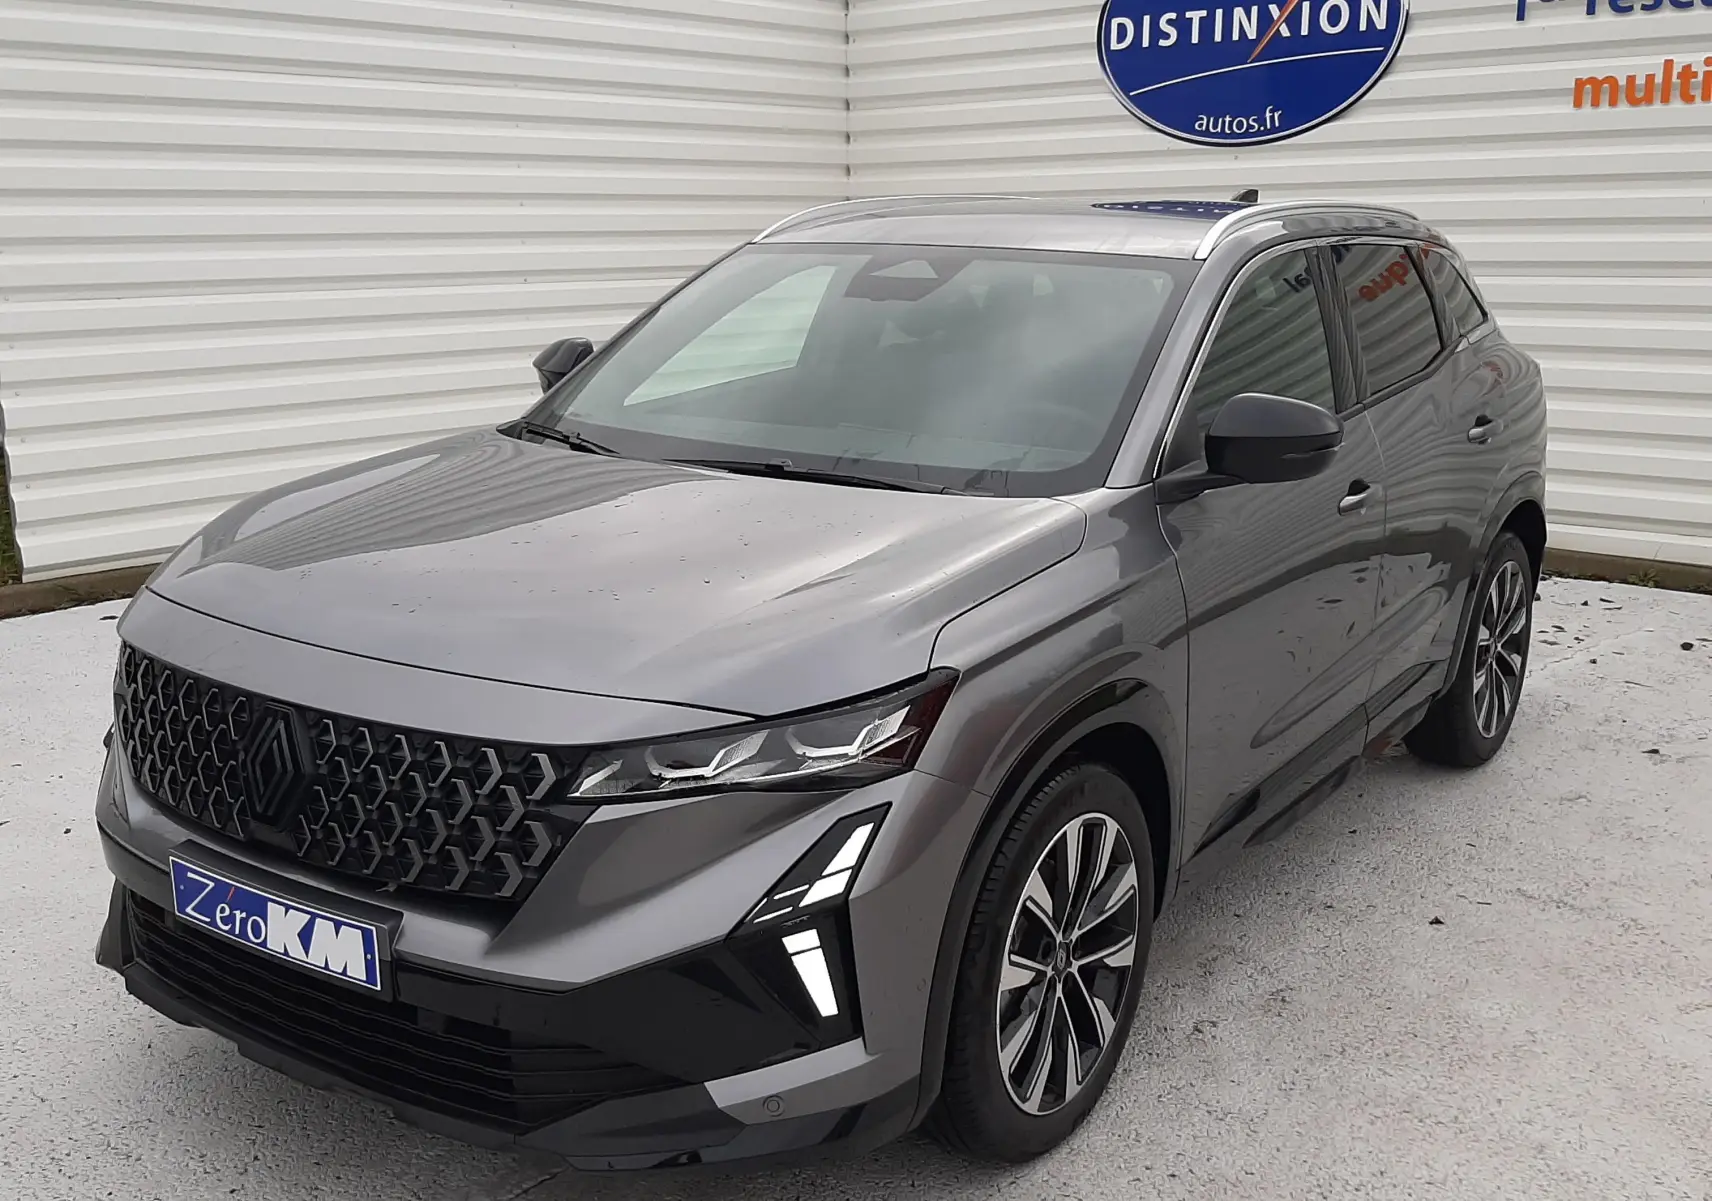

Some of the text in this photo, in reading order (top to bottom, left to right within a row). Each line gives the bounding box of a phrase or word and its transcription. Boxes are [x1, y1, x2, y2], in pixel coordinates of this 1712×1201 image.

[1109, 0, 1388, 50] DISTINXION
[1572, 56, 1712, 108] multi
[1194, 106, 1282, 134] autos.fr
